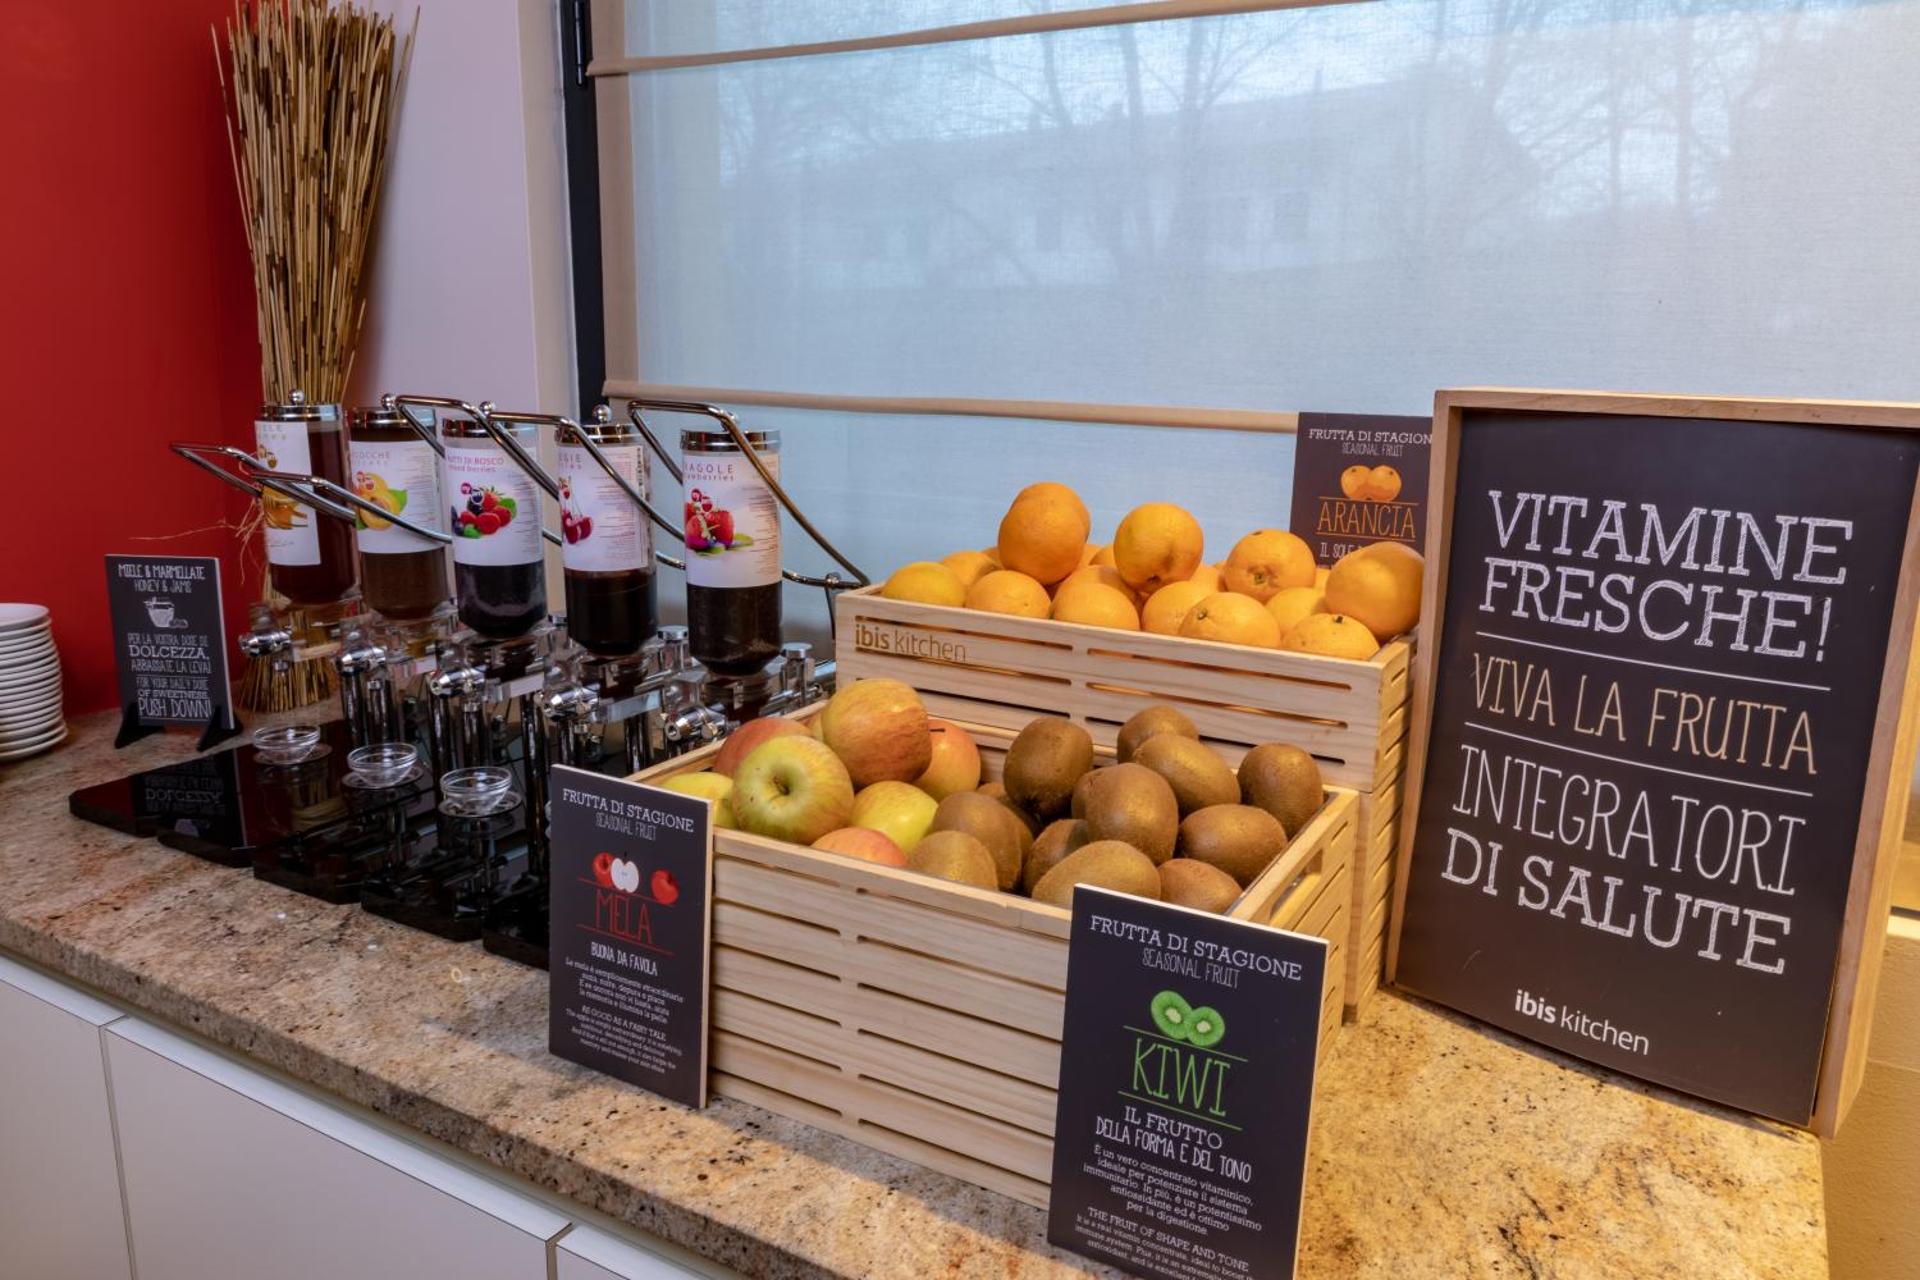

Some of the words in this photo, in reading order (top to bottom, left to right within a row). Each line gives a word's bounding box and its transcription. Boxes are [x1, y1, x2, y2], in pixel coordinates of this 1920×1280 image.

[1308, 428, 1355, 441] FRUTTA
[1358, 430, 1372, 442] DI
[1374, 432, 1433, 445] STAGION
[474, 456, 505, 465] BOSCO
[1316, 501, 1416, 538] ARANCIA
[1488, 490, 1854, 585] VITAMINE
[145, 565, 151, 578] &
[1319, 542, 1330, 558] IL
[1478, 556, 1832, 662] FRESCHE!
[855, 624, 890, 650] ibis
[894, 630, 966, 662] kitchen
[138, 697, 168, 717] PUSH
[1472, 652, 1556, 727] VIVA
[1573, 673, 1626, 742] LA
[1648, 687, 1818, 775] FRUTTA
[563, 788, 608, 812] FRUTTA
[611, 800, 624, 815] DI
[626, 804, 694, 832] STAGIONE
[595, 812, 632, 836] SEASONAL
[635, 822, 656, 841] FRUIT
[1452, 743, 1806, 896] INTEGRATORI
[596, 888, 652, 943] MELA
[1441, 826, 1503, 897] DI
[1518, 854, 1792, 975] SALUTE
[590, 941, 615, 962] BUONA
[616, 950, 628, 967] DA
[629, 954, 658, 976] FAVOLA
[1090, 915, 1162, 947] FRUTTA
[1168, 934, 1188, 952] DI
[1194, 940, 1302, 981] STAGIONE
[1142, 948, 1201, 980] SEASONAL
[1205, 963, 1240, 989] FRUIT
[1515, 988, 1557, 1025] ibis
[1560, 1004, 1649, 1056] kitchen
[1133, 1038, 1230, 1117] KIWI
[1096, 1115, 1130, 1146] DELLA
[1134, 1128, 1175, 1160] FORMA
[1180, 1143, 1188, 1164] E
[1192, 1147, 1214, 1172] DEL
[1220, 1154, 1252, 1183] TONO
[1124, 1106, 1142, 1125] IL
[1146, 1112, 1222, 1150] FRUTTO
[1098, 1156, 1126, 1174] ideale
[1128, 1168, 1146, 1181] per
[1148, 1175, 1199, 1199] potenziare
[1201, 1191, 1208, 1202] il
[1208, 1196, 1248, 1216] sistema
[1102, 1149, 1115, 1160] un
[1116, 1154, 1139, 1167] vero
[1140, 1161, 1198, 1187] concentrato
[1110, 1186, 1172, 1212] antiossidante
[1174, 1206, 1188, 1216] ed
[1198, 1215, 1230, 1232] ottimo
[1126, 1200, 1144, 1213] per
[1146, 1206, 1154, 1216] la
[1184, 1198, 1196, 1208] un
[1198, 1204, 1262, 1232] potentissimo
[1088, 1206, 1108, 1221] THE
[1110, 1214, 1138, 1232] FRUIT
[1140, 1225, 1155, 1238] OF
[1156, 1231, 1190, 1252] SHAPE
[1192, 1244, 1216, 1260] AND
